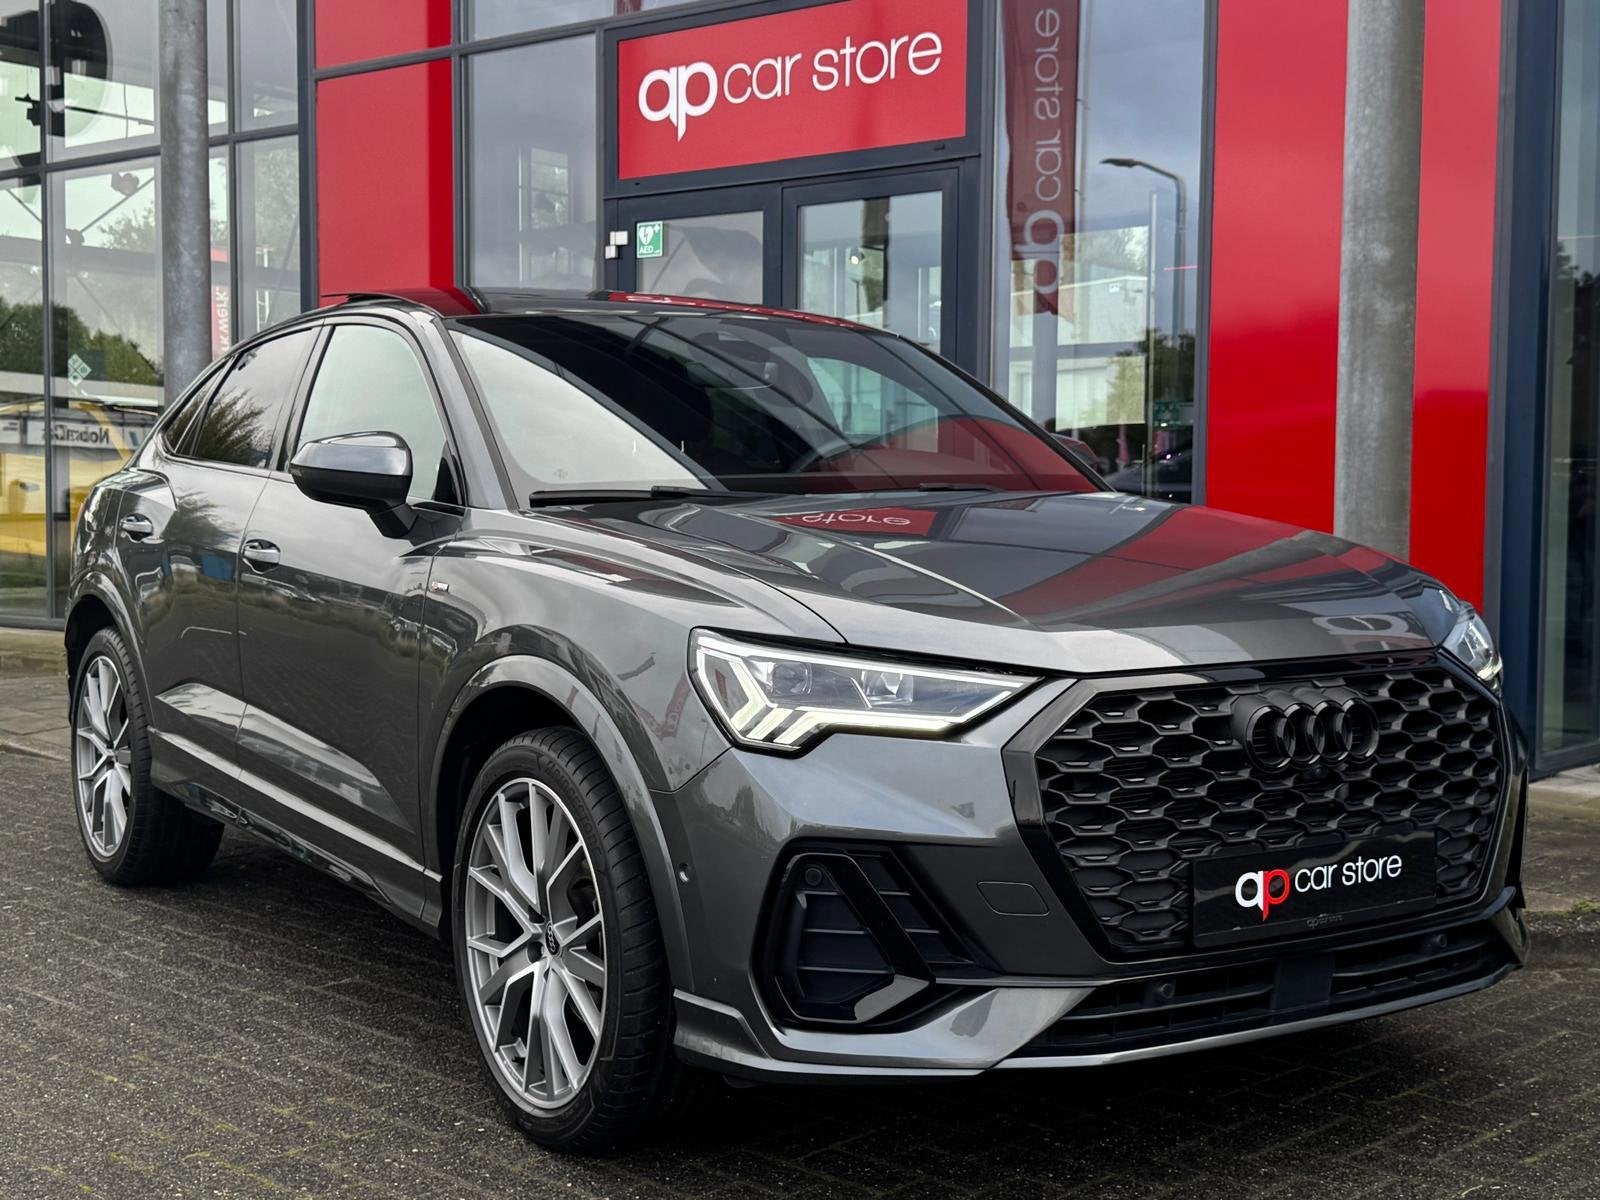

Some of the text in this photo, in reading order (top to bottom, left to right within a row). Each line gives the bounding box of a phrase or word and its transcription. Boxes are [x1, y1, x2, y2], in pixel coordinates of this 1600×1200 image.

[638, 31, 942, 142] ap car store
[639, 245, 654, 254] AED
[1235, 854, 1402, 922] ap car store
